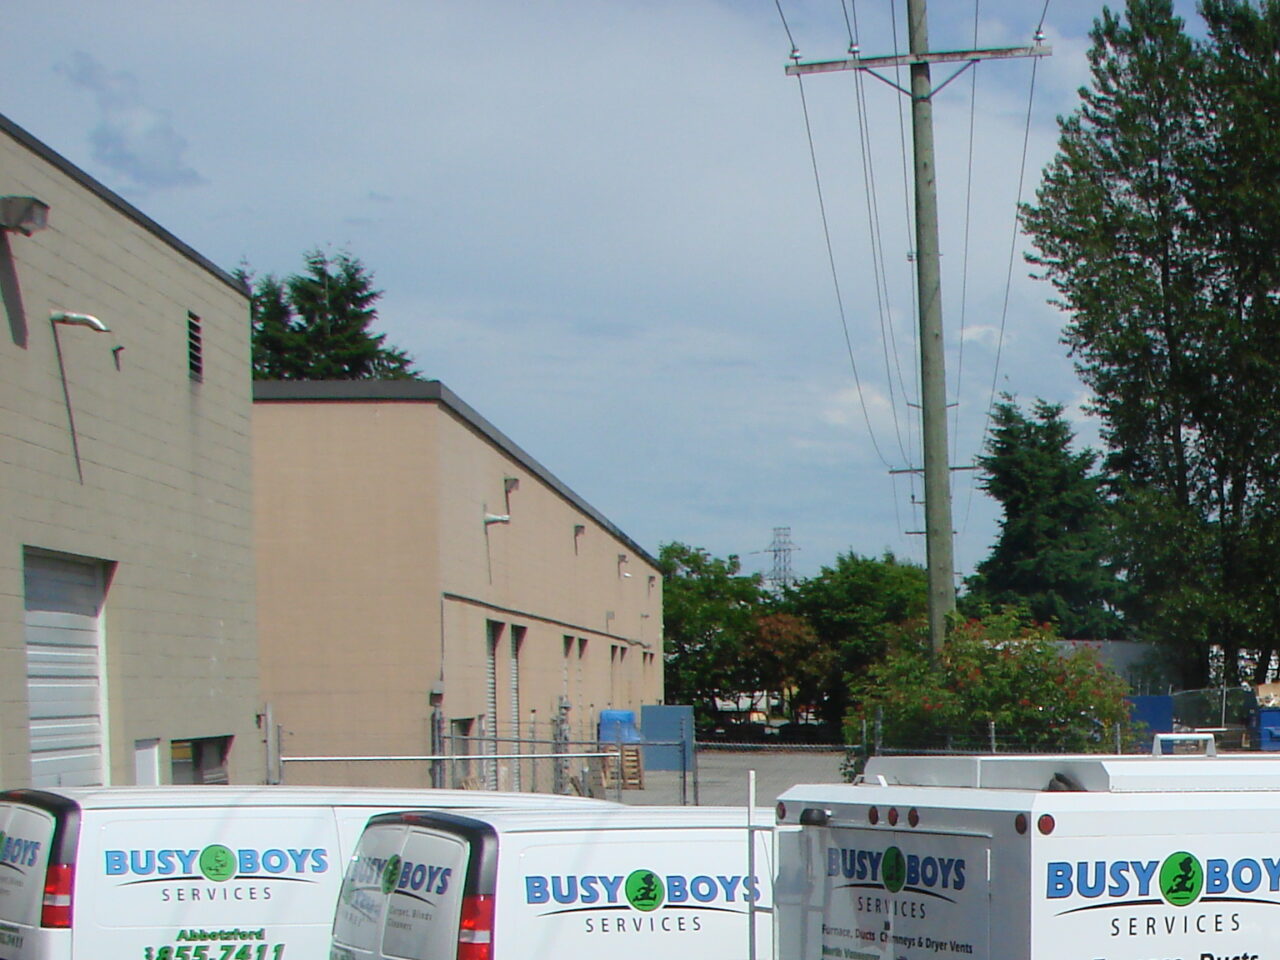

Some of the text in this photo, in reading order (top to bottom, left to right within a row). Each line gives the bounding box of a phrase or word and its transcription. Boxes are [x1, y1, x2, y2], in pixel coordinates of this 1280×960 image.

[105, 849, 328, 875] BUSY BOYS
[827, 848, 966, 891] BUSY BOYS
[398, 861, 452, 895] BOYS
[525, 875, 760, 904] BUSY BOYS
[1046, 860, 1160, 899] BUSY
[162, 887, 272, 901] SERVICES
[858, 896, 926, 919] SERVICES
[176, 928, 265, 941] Abbotsford
[585, 916, 702, 933] SERVICES
[1111, 913, 1241, 936] SERVICES
[880, 931, 916, 949] Chmneys
[917, 937, 923, 947] &
[925, 938, 948, 953] Dryer
[950, 940, 973, 954] Vents
